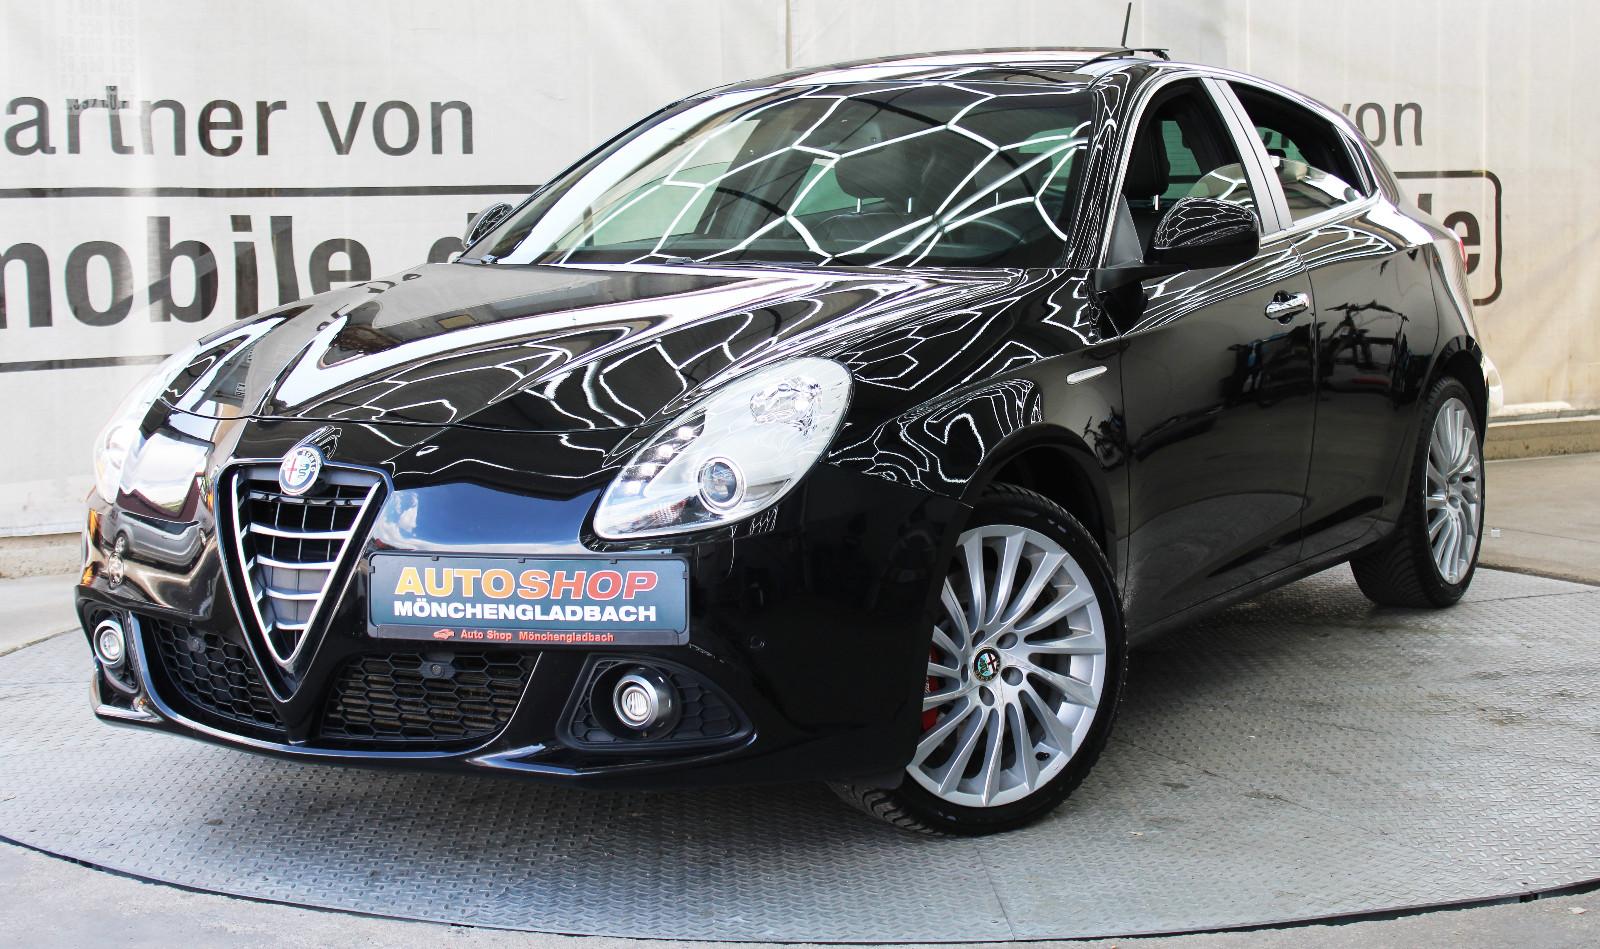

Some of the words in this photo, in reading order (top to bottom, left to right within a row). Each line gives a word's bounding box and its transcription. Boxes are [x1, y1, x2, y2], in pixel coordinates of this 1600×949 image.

[4, 85, 287, 156] artner
[317, 100, 475, 156] von
[1342, 102, 1423, 147] on
[394, 566, 659, 601] AUTOSHOP
[394, 598, 657, 622] MÖNCHENGLADBACH
[460, 629, 484, 640] Auto
[486, 630, 513, 642] Shop
[518, 631, 615, 643] Mönchengladbach
